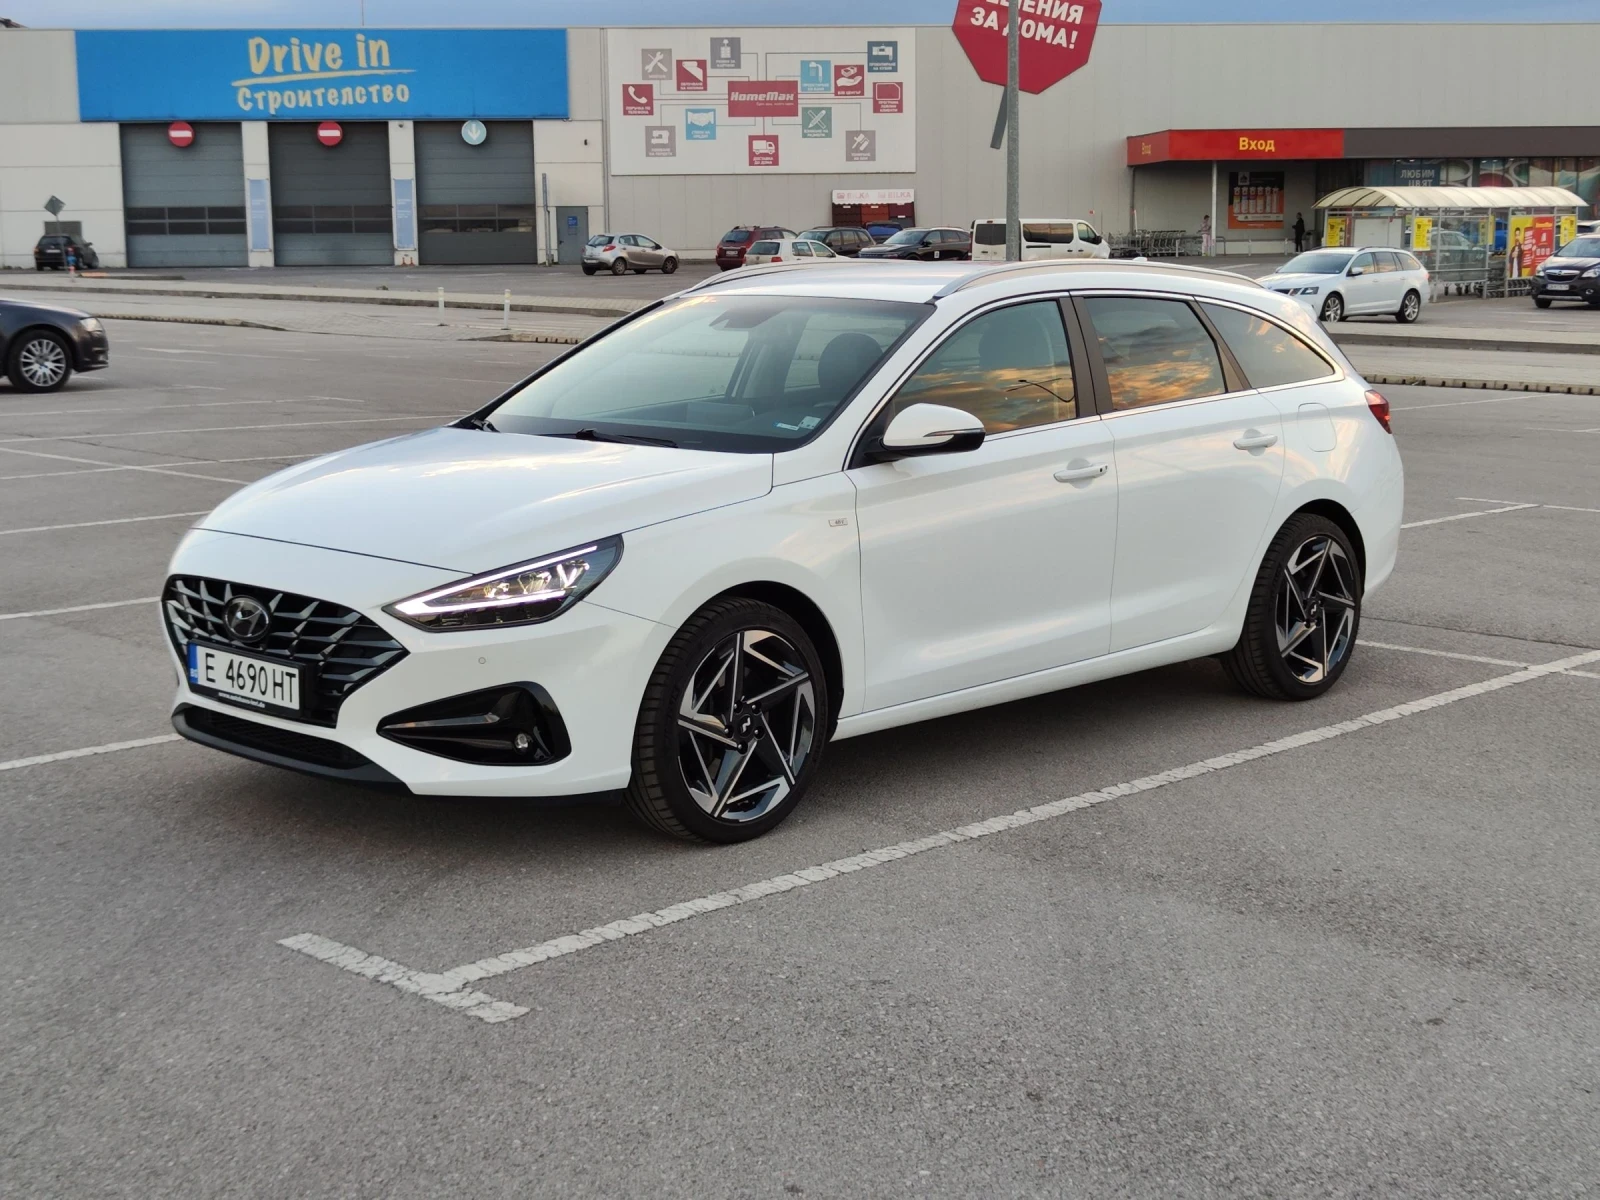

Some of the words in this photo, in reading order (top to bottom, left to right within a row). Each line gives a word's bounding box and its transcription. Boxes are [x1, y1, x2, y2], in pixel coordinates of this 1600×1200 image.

[970, 7, 1000, 31] ЗА
[247, 35, 344, 75] Drive
[355, 33, 391, 69] in
[237, 83, 410, 115] Строителство
[730, 91, 795, 101] HomeMax
[1239, 137, 1276, 152] Вход
[1400, 169, 1435, 179] ЛЮБИМ
